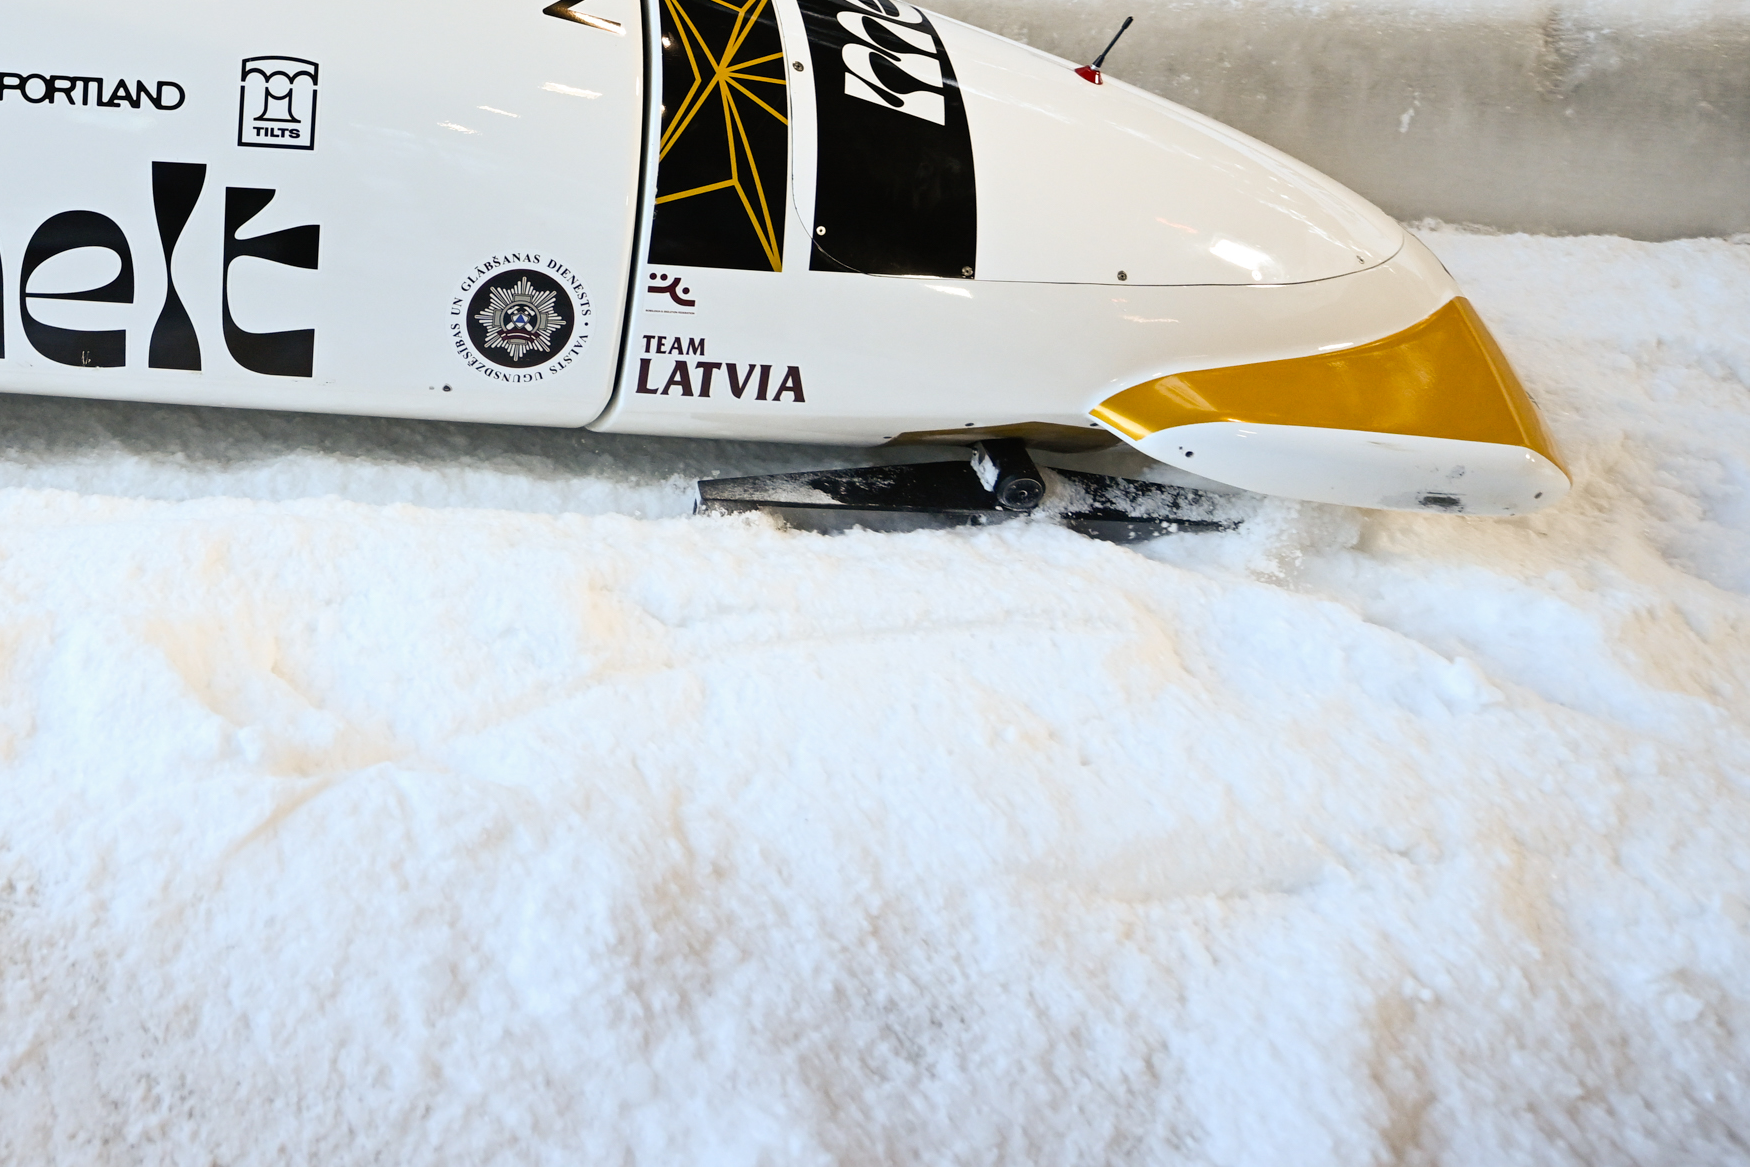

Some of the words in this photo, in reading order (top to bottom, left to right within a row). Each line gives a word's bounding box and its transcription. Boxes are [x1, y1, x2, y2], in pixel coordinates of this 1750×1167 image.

[253, 126, 301, 140] TILTS
[451, 297, 464, 316] UN
[461, 252, 541, 292] GLĀBŠANAS
[546, 258, 592, 316] DIENESTS
[450, 323, 544, 383] UGUNSDZĒSĪBAS
[549, 334, 589, 375] VALSTS
[642, 334, 706, 356] TEAM
[635, 358, 806, 403] LATVIA
